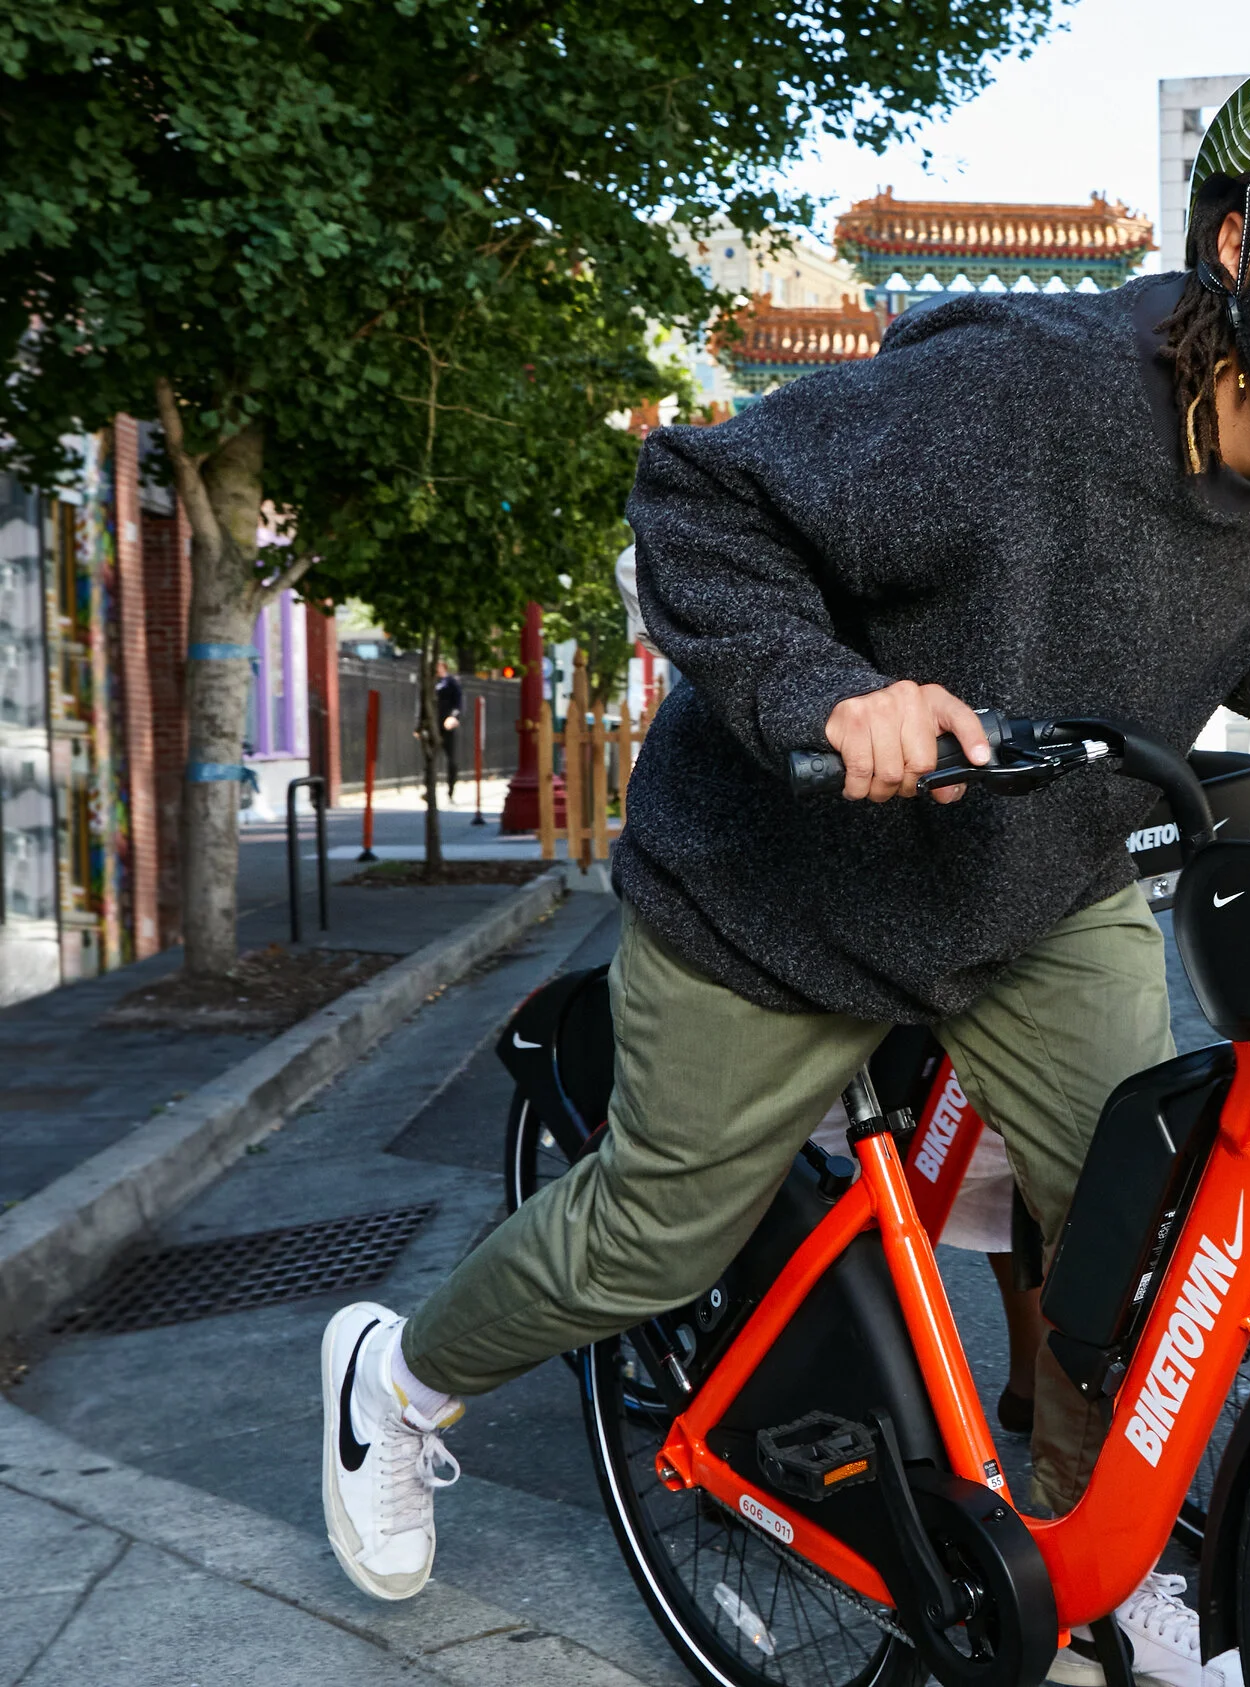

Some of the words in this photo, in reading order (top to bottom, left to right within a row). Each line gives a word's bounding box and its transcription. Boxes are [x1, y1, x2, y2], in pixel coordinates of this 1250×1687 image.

[1125, 822, 1180, 854] KETO
[914, 1069, 969, 1184] BIKETO
[1124, 1234, 1238, 1468] BIKETOWN
[991, 1476, 1002, 1488] 55
